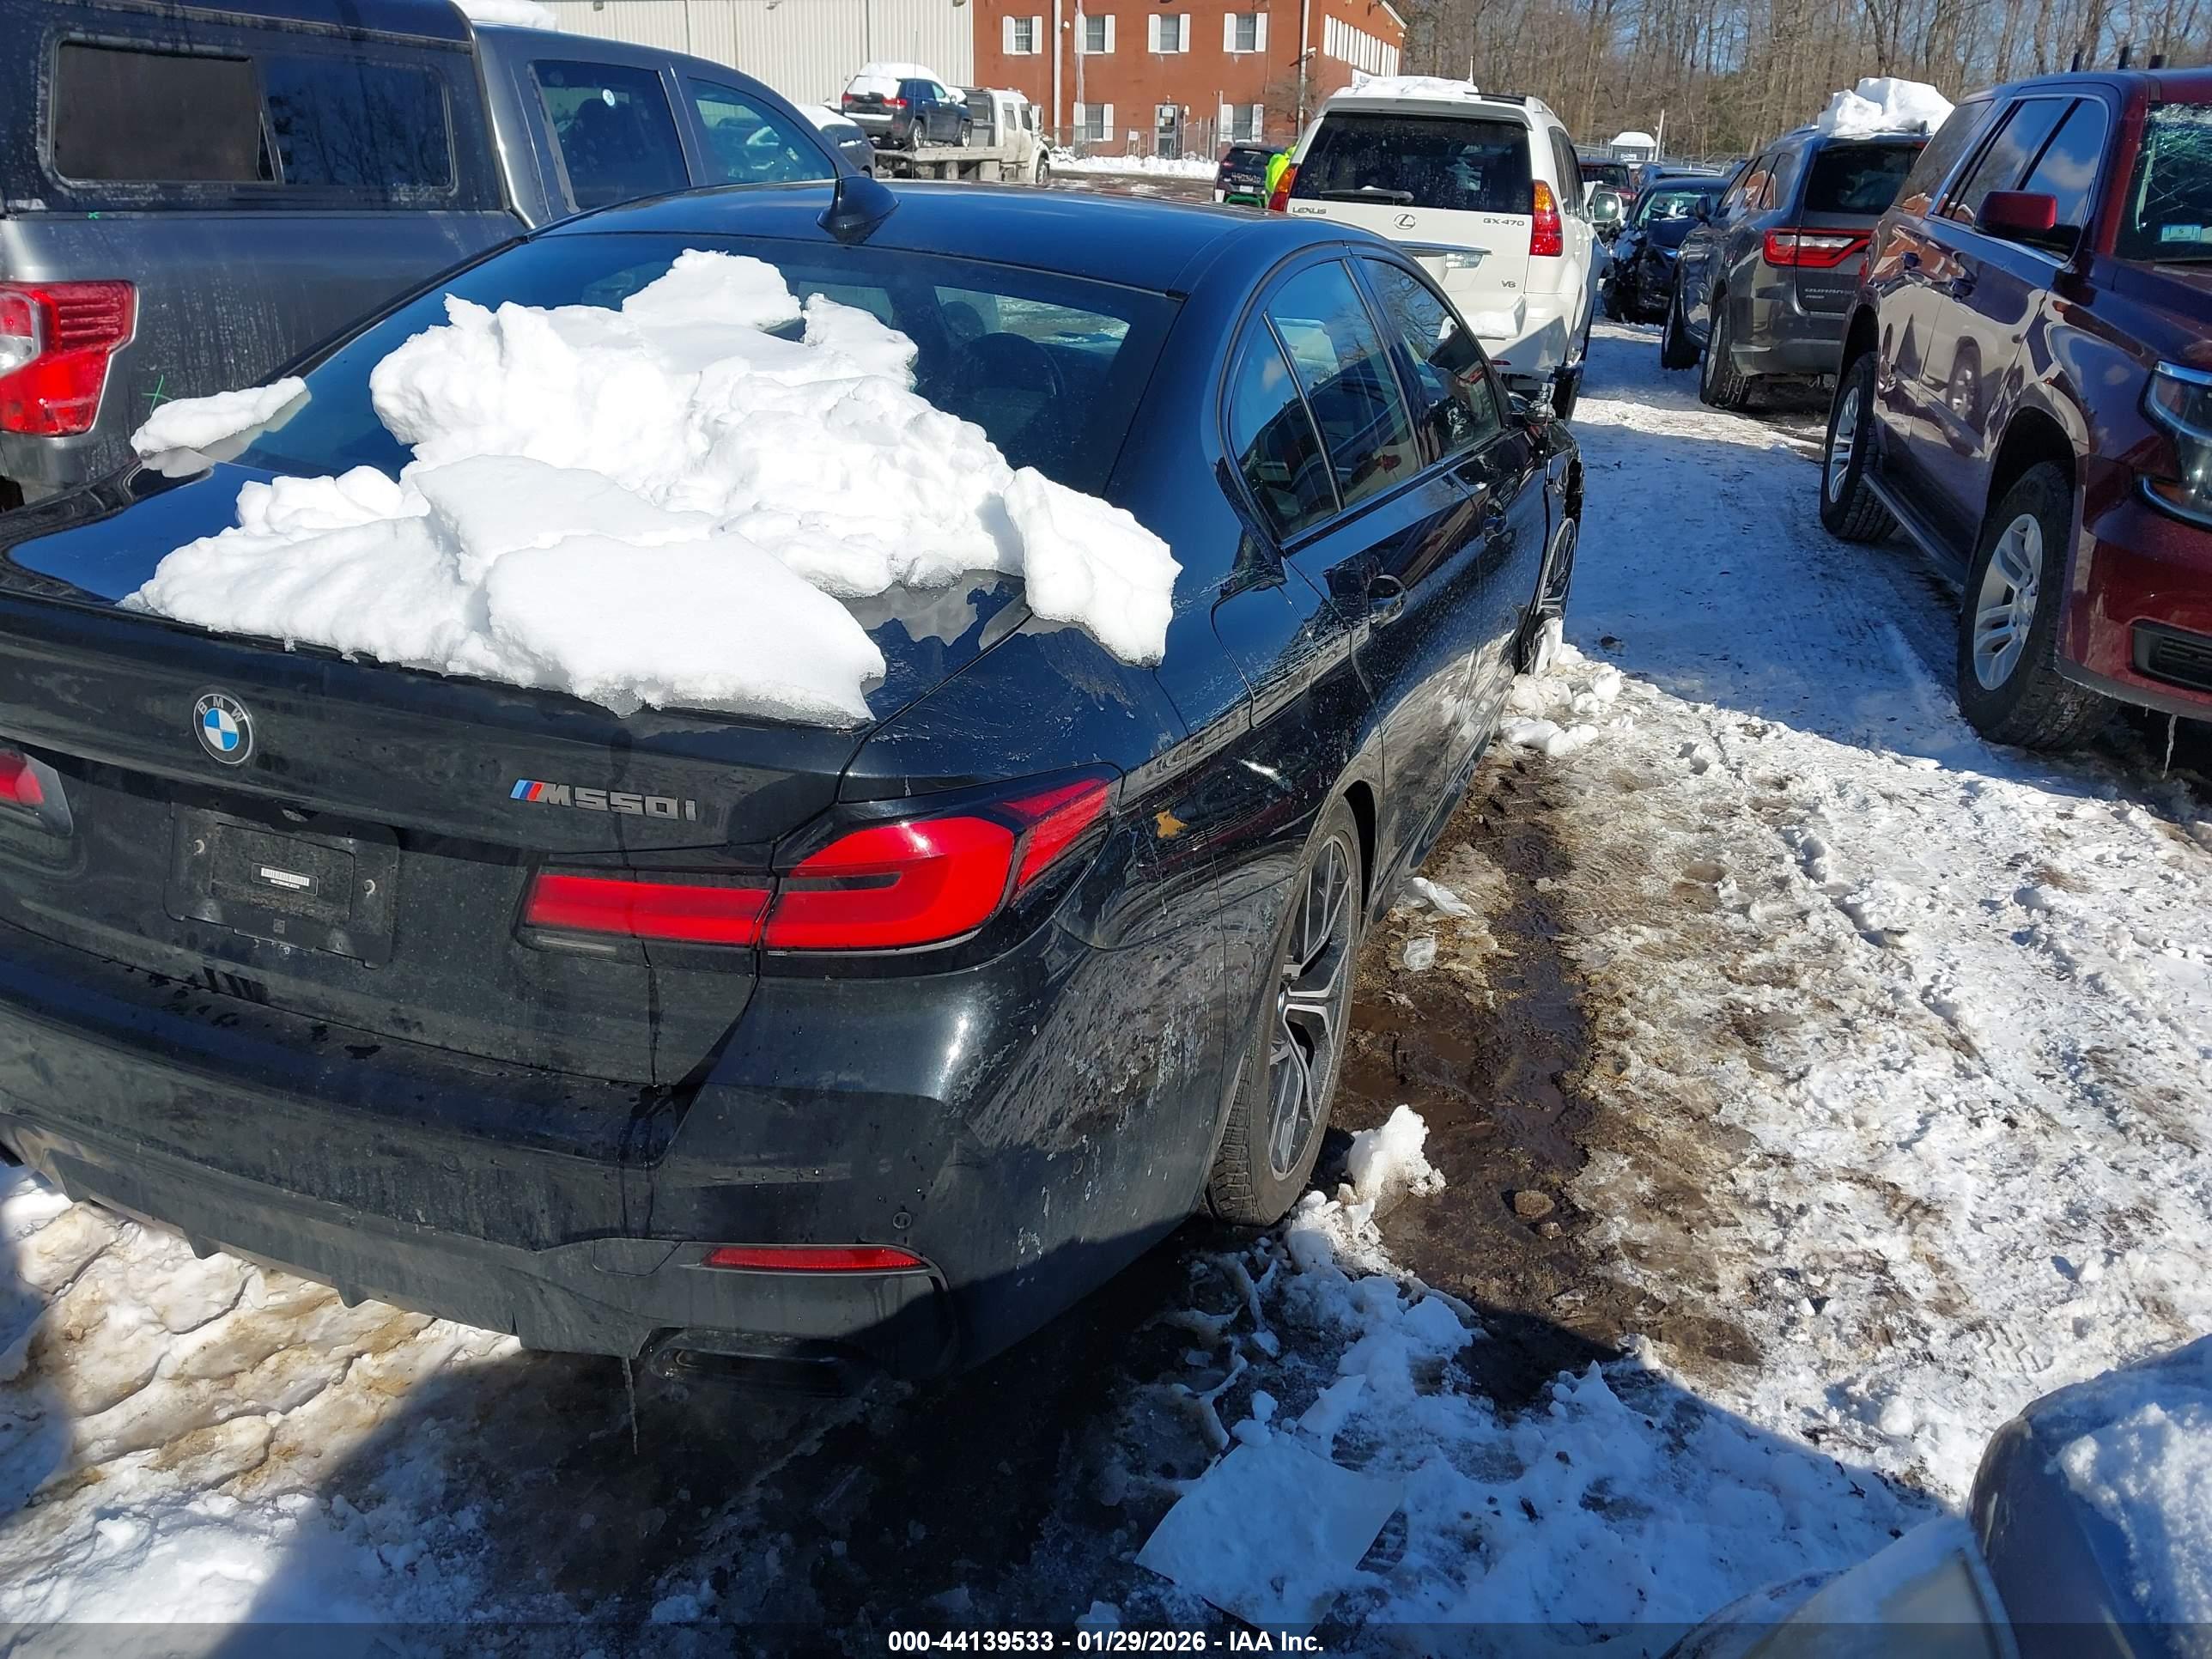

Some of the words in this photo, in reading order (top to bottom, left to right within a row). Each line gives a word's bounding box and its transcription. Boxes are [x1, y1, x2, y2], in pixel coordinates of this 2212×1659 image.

[1483, 217, 1525, 227] GX470
[198, 696, 245, 723] BMW
[538, 781, 696, 821] M550i
